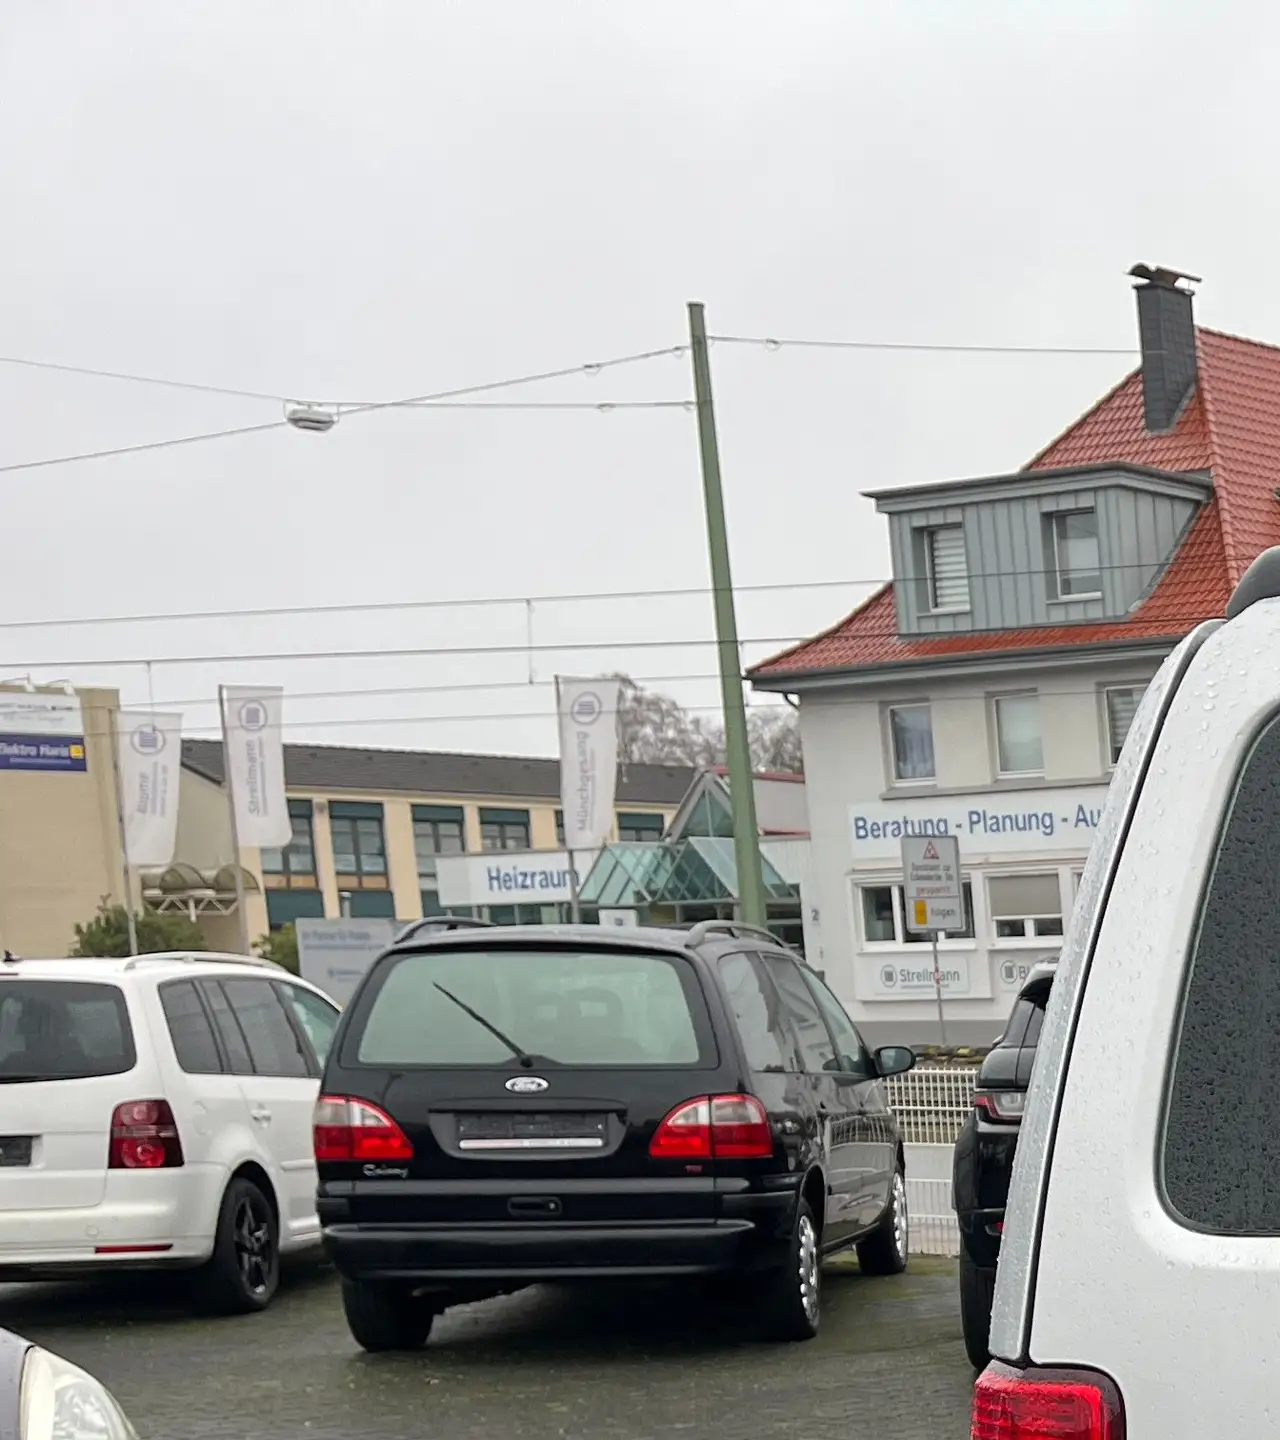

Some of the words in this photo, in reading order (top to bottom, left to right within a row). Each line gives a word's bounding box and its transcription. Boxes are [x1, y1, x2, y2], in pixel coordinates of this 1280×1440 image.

[854, 816, 949, 840] Beratung
[968, 809, 1054, 836] Planung
[486, 866, 581, 892] Heizraum
